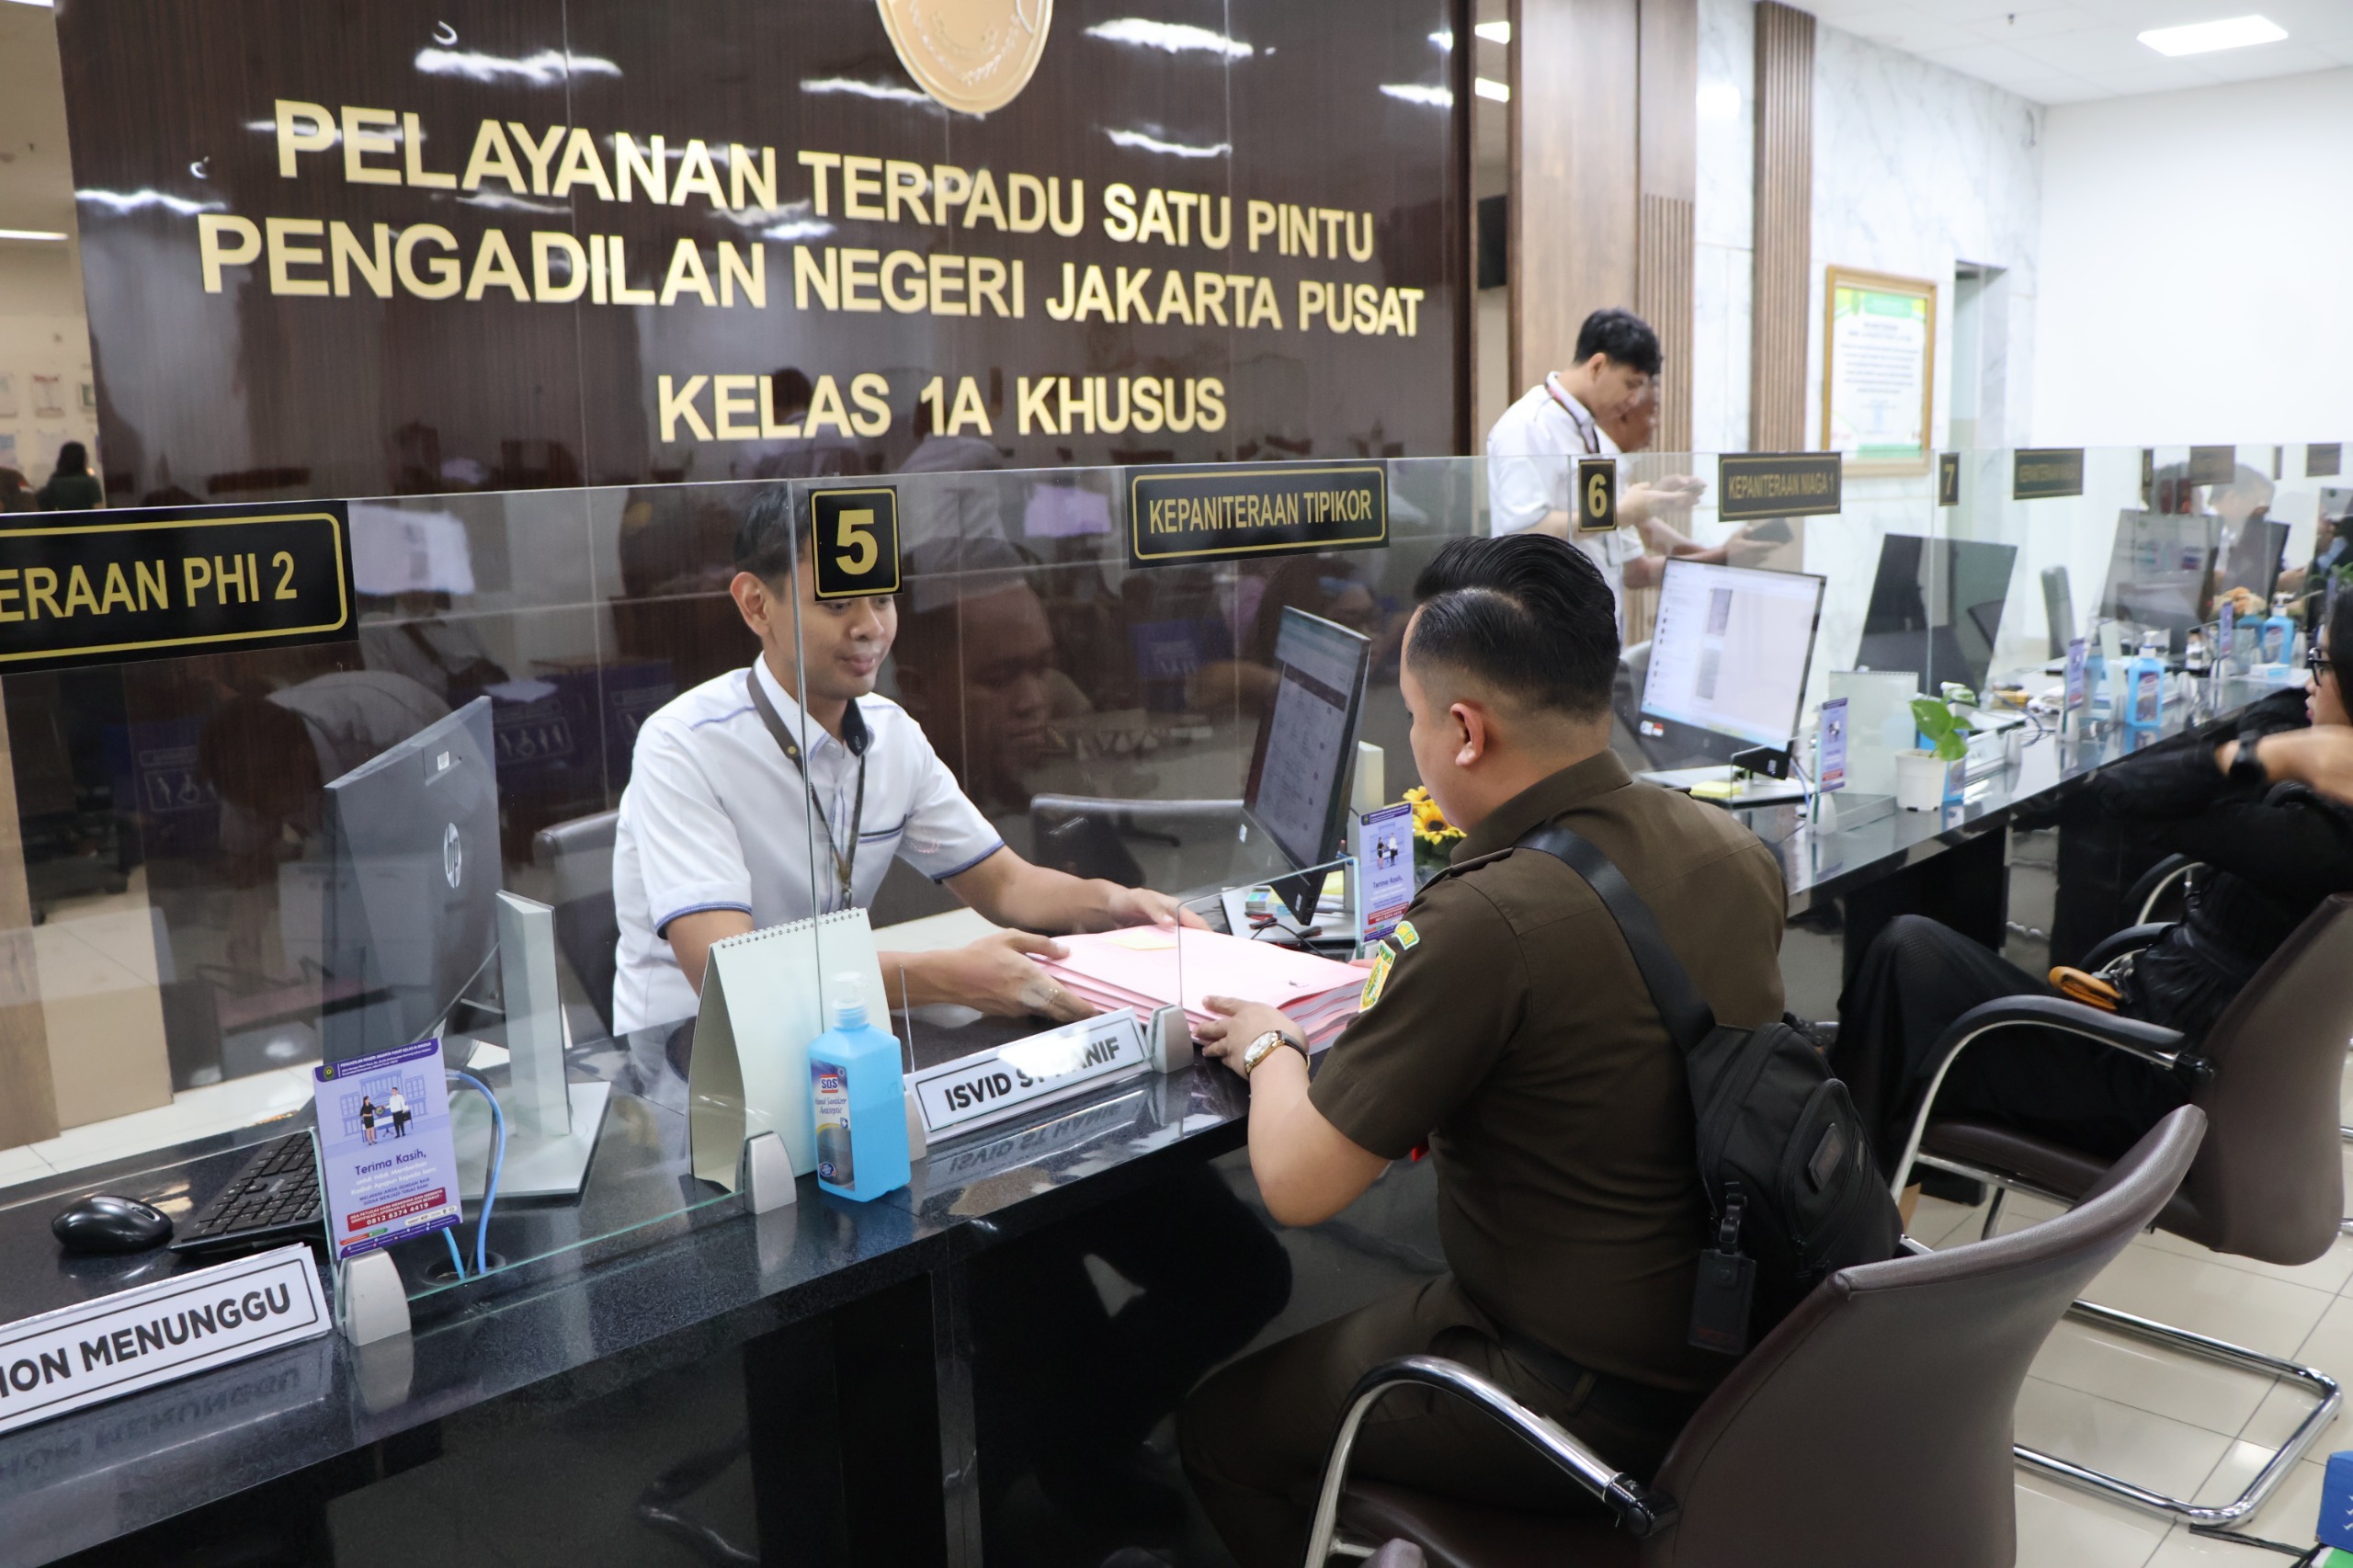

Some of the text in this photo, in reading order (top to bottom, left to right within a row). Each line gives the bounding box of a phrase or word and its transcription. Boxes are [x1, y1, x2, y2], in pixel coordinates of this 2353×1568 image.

[274, 98, 1374, 262] PELAYANAN TERPADU SATU PINTU
[198, 213, 1425, 336] PENGADILAN NEGERI JAKARTA PUSAT
[657, 373, 1227, 441] KELAS 1A KHUSUS
[1587, 473, 1608, 518] 6
[1729, 473, 1799, 499] KEPANITERAAN
[1801, 472, 1828, 494] NIAGA
[1944, 463, 1955, 494] 7
[1150, 489, 1372, 534] KEPANITERAAN TIPIKOR
[836, 508, 878, 575] 5
[183, 553, 259, 607] PHI
[272, 551, 298, 600] 2
[444, 823, 461, 888] hp
[944, 1073, 1012, 1112] ISVID
[355, 1149, 426, 1176] Terima Kasih,
[367, 1201, 428, 1225] 0812 8374 4419
[79, 1282, 290, 1371] MENUNGGU
